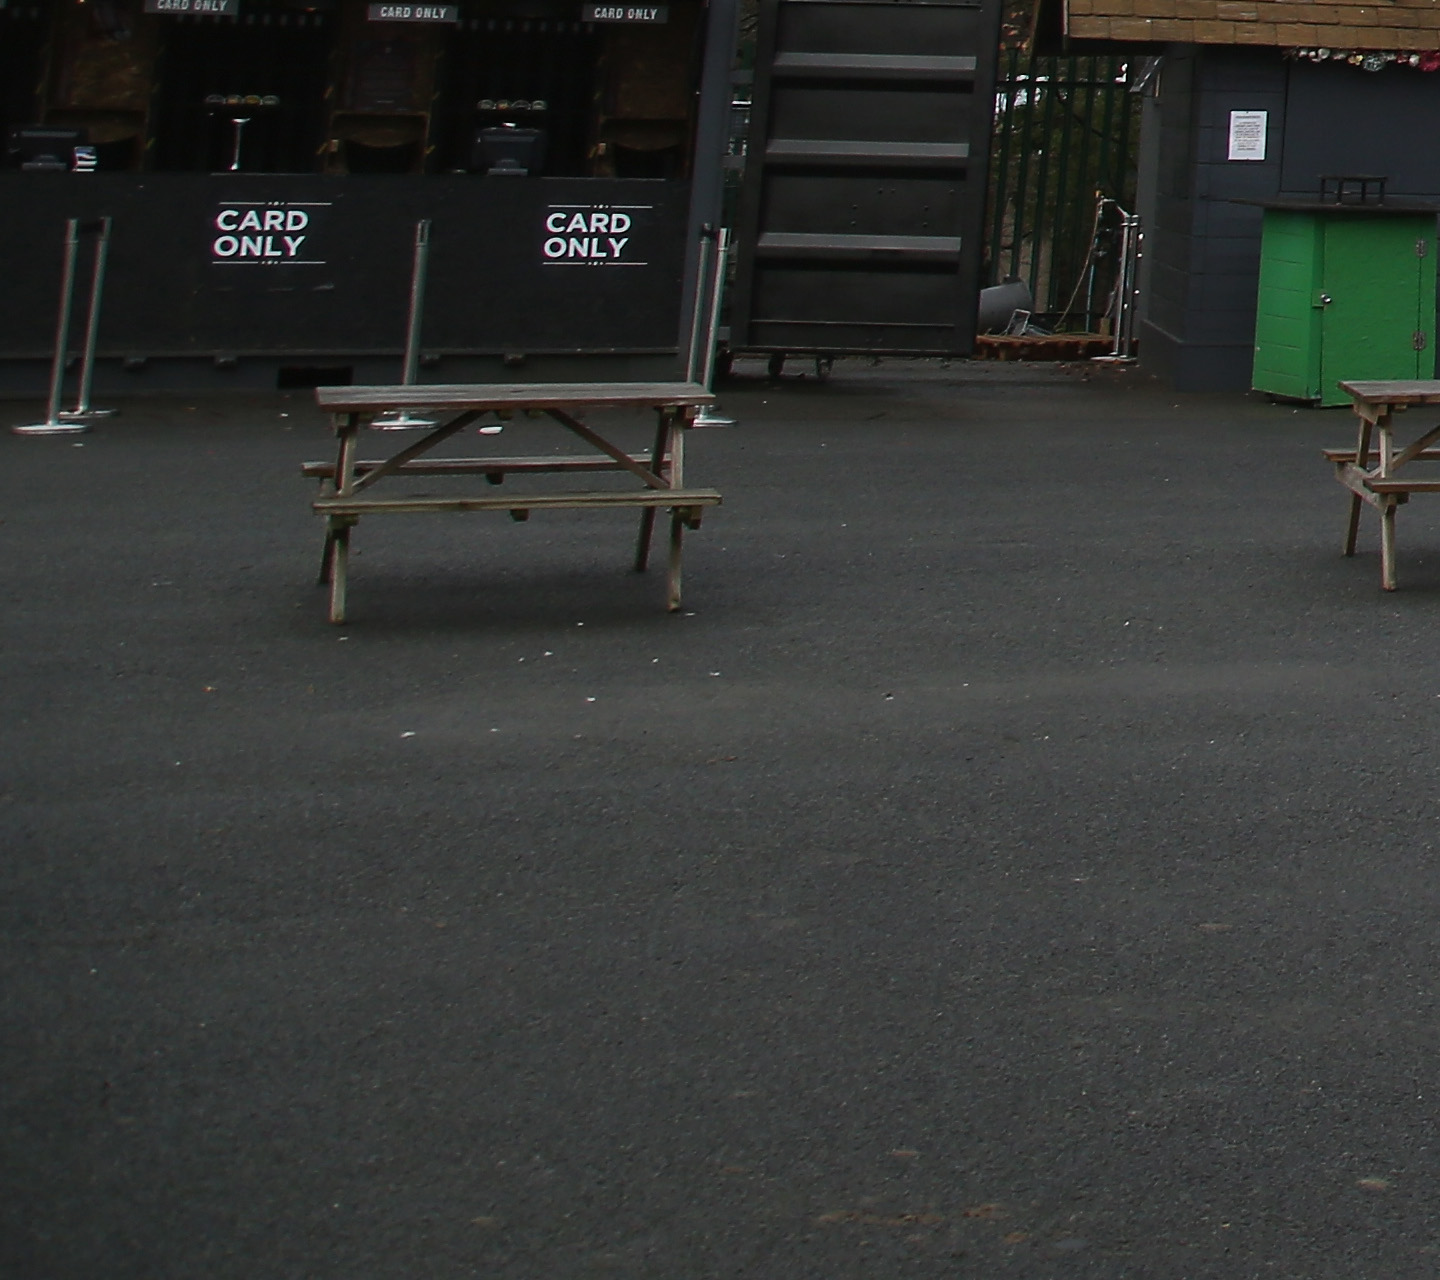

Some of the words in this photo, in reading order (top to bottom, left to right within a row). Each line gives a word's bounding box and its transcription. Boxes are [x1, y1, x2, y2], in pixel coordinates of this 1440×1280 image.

[194, 0, 228, 11] ONLY
[381, 6, 411, 18] CARD
[416, 7, 447, 19] ONLY
[594, 7, 623, 19] CARD
[628, 8, 657, 20] ONLY
[217, 209, 309, 231] CARD
[546, 212, 631, 233] CARD
[213, 235, 306, 257] ONLY
[543, 237, 629, 258] ONLY
